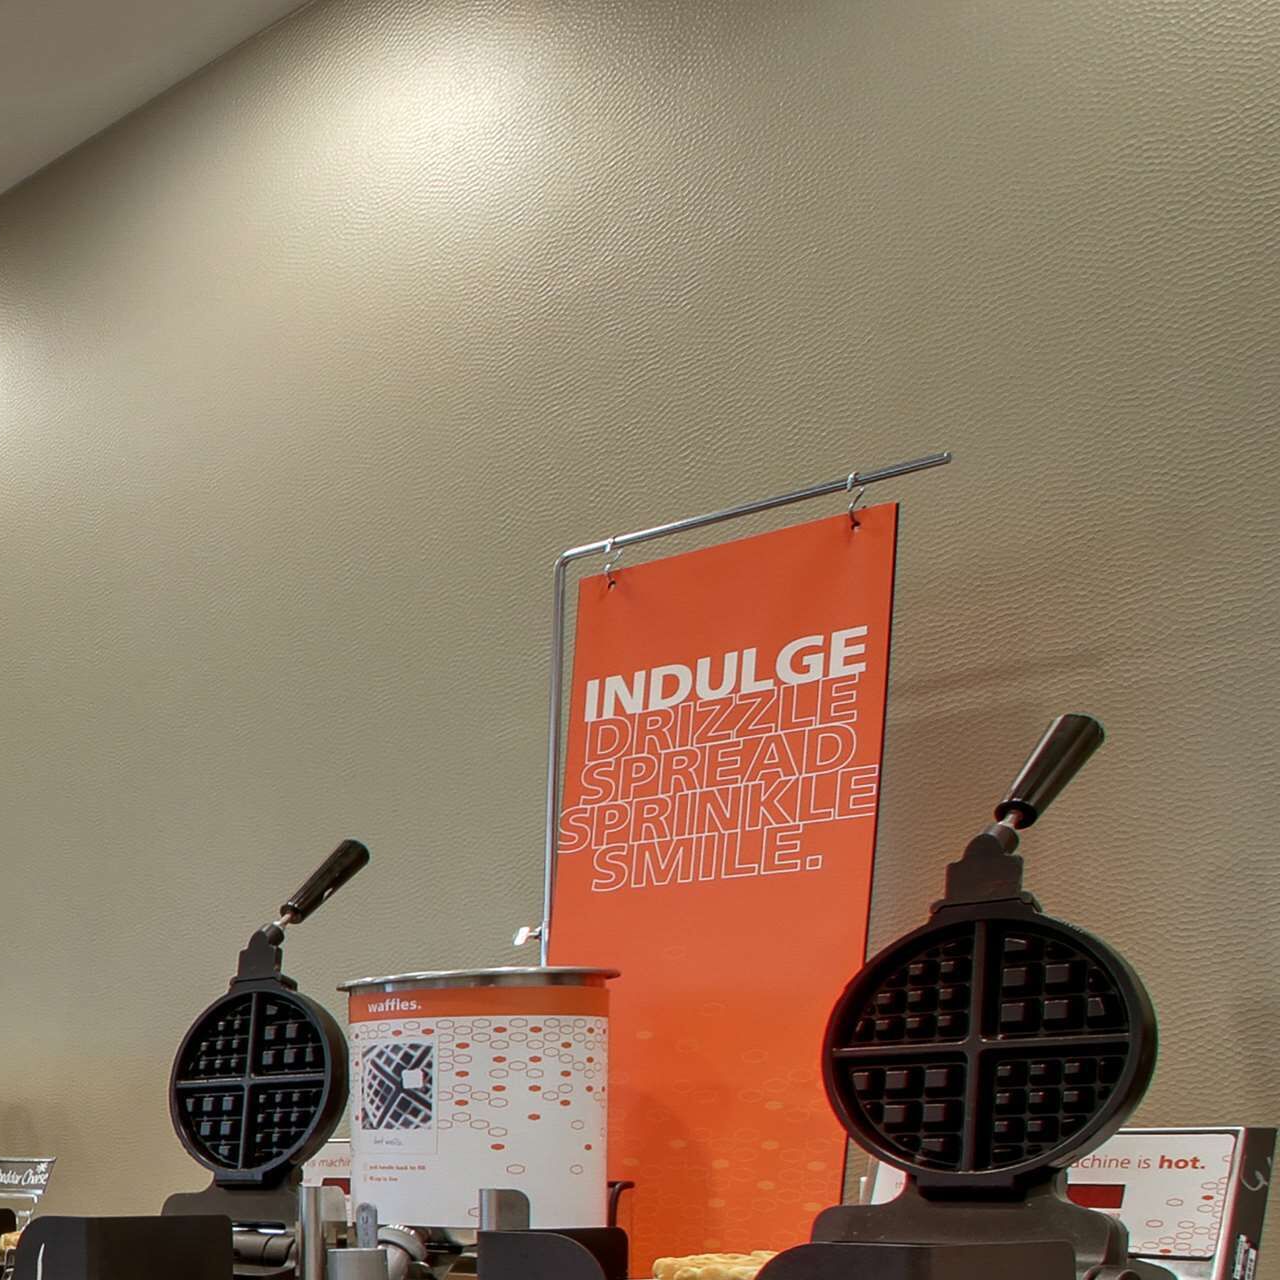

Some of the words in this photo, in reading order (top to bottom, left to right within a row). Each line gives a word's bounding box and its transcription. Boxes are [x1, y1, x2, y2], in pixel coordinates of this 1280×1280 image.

[584, 625, 869, 722] INDULGE
[585, 673, 859, 765] DRIZZLE
[579, 723, 858, 806] SPREAD
[558, 765, 879, 854] SPRINKLE
[592, 823, 823, 892] SMILE.
[368, 997, 422, 1014] waffles.
[1071, 1154, 1131, 1170] achine
[1137, 1156, 1151, 1169] is
[1159, 1154, 1206, 1170] hot.
